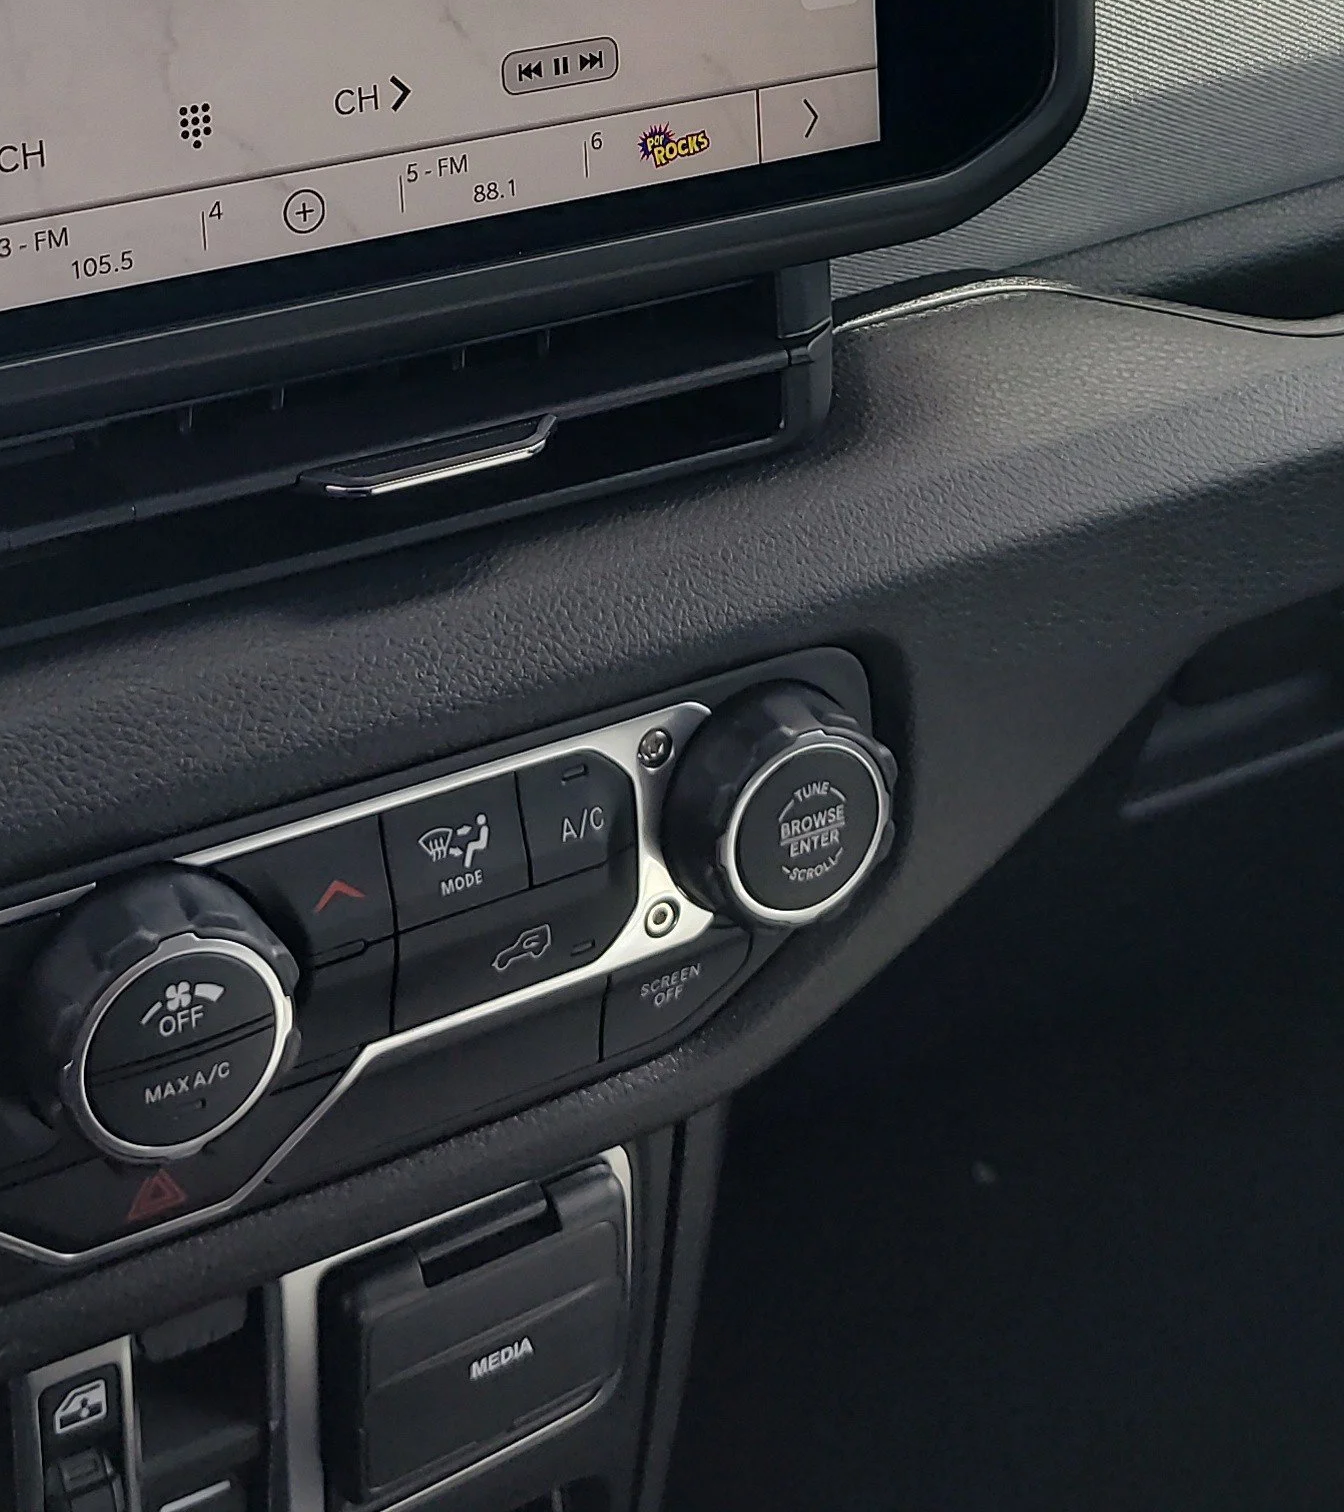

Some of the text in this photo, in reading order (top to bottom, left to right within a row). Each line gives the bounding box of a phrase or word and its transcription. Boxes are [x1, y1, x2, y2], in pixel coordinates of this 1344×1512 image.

[334, 85, 380, 116] CH
[591, 131, 602, 151] 6
[653, 132, 710, 166] ROCKS
[406, 163, 419, 183] 5
[438, 154, 469, 179] FM
[473, 178, 518, 204] 88.1
[208, 201, 223, 222] 4
[35, 227, 70, 252] FM
[71, 250, 135, 281] 105.5
[794, 781, 831, 804] TUNE
[561, 805, 605, 844] A/C
[780, 804, 845, 839] BROWSE
[789, 829, 840, 859] ENTER
[440, 869, 484, 897] MODE
[789, 855, 837, 882] SCROLL
[640, 963, 702, 999] SCREEN
[654, 986, 684, 1008] OFF
[159, 1005, 204, 1038] OFF
[145, 1061, 230, 1104] MAX A/C
[469, 1336, 534, 1380] MEDIA
